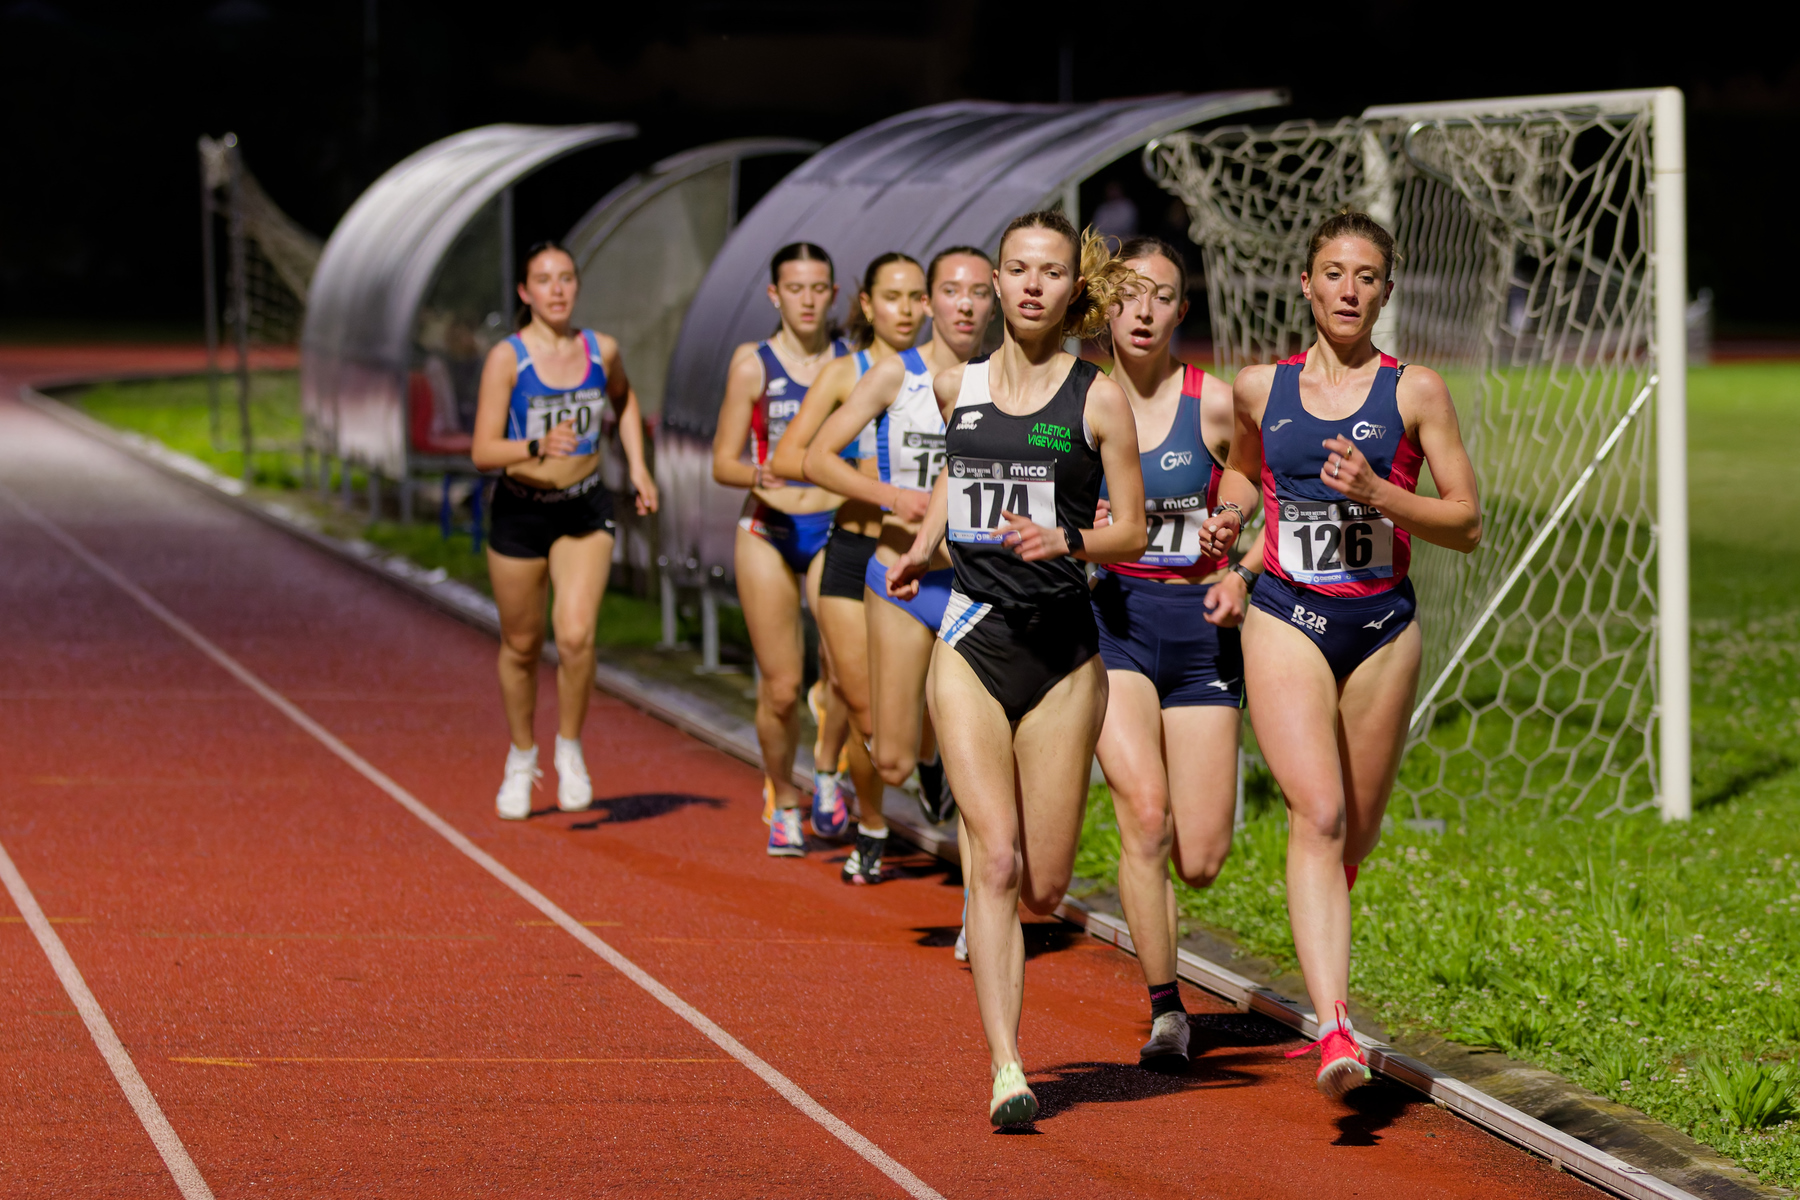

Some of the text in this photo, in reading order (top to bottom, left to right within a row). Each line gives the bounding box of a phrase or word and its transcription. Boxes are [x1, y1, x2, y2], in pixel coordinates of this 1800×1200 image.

[1028, 434, 1071, 453] VIGEVANO
[1032, 423, 1071, 439] ATLETICA
[1352, 421, 1387, 440] GAV
[913, 451, 948, 488] 13
[1161, 451, 1192, 471] GAV
[962, 482, 1032, 529] 174
[1146, 514, 1185, 553] 27
[1293, 523, 1373, 570] 126
[1292, 604, 1327, 631] R2R
